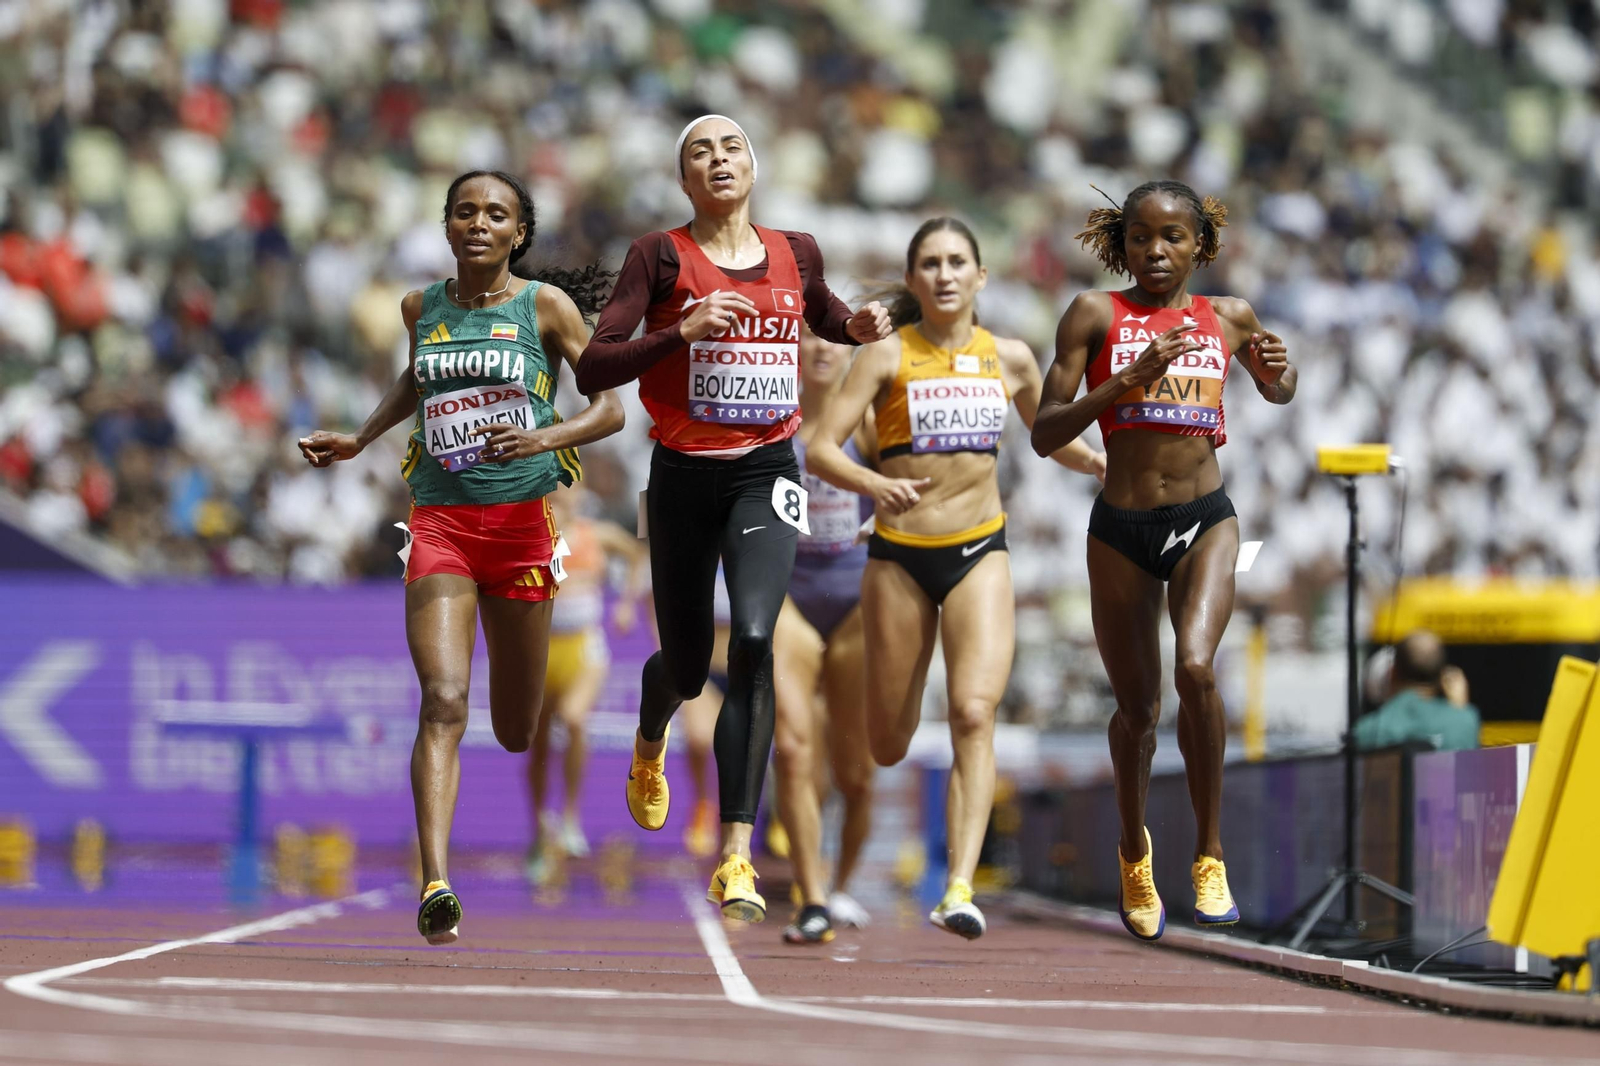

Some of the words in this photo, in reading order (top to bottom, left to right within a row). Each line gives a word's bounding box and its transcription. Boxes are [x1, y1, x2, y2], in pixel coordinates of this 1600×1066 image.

[709, 317, 799, 341] NISIA
[1120, 327, 1222, 350] BAAIN
[414, 350, 525, 383] ETHIOPIA
[692, 349, 795, 366] HONDA
[1115, 350, 1222, 370] HDA
[694, 374, 794, 400] BOUZAYANI
[913, 386, 1000, 400] HONDA
[426, 389, 526, 419] HONDA
[917, 407, 1002, 431] KRAUSE
[784, 489, 800, 522] 8
